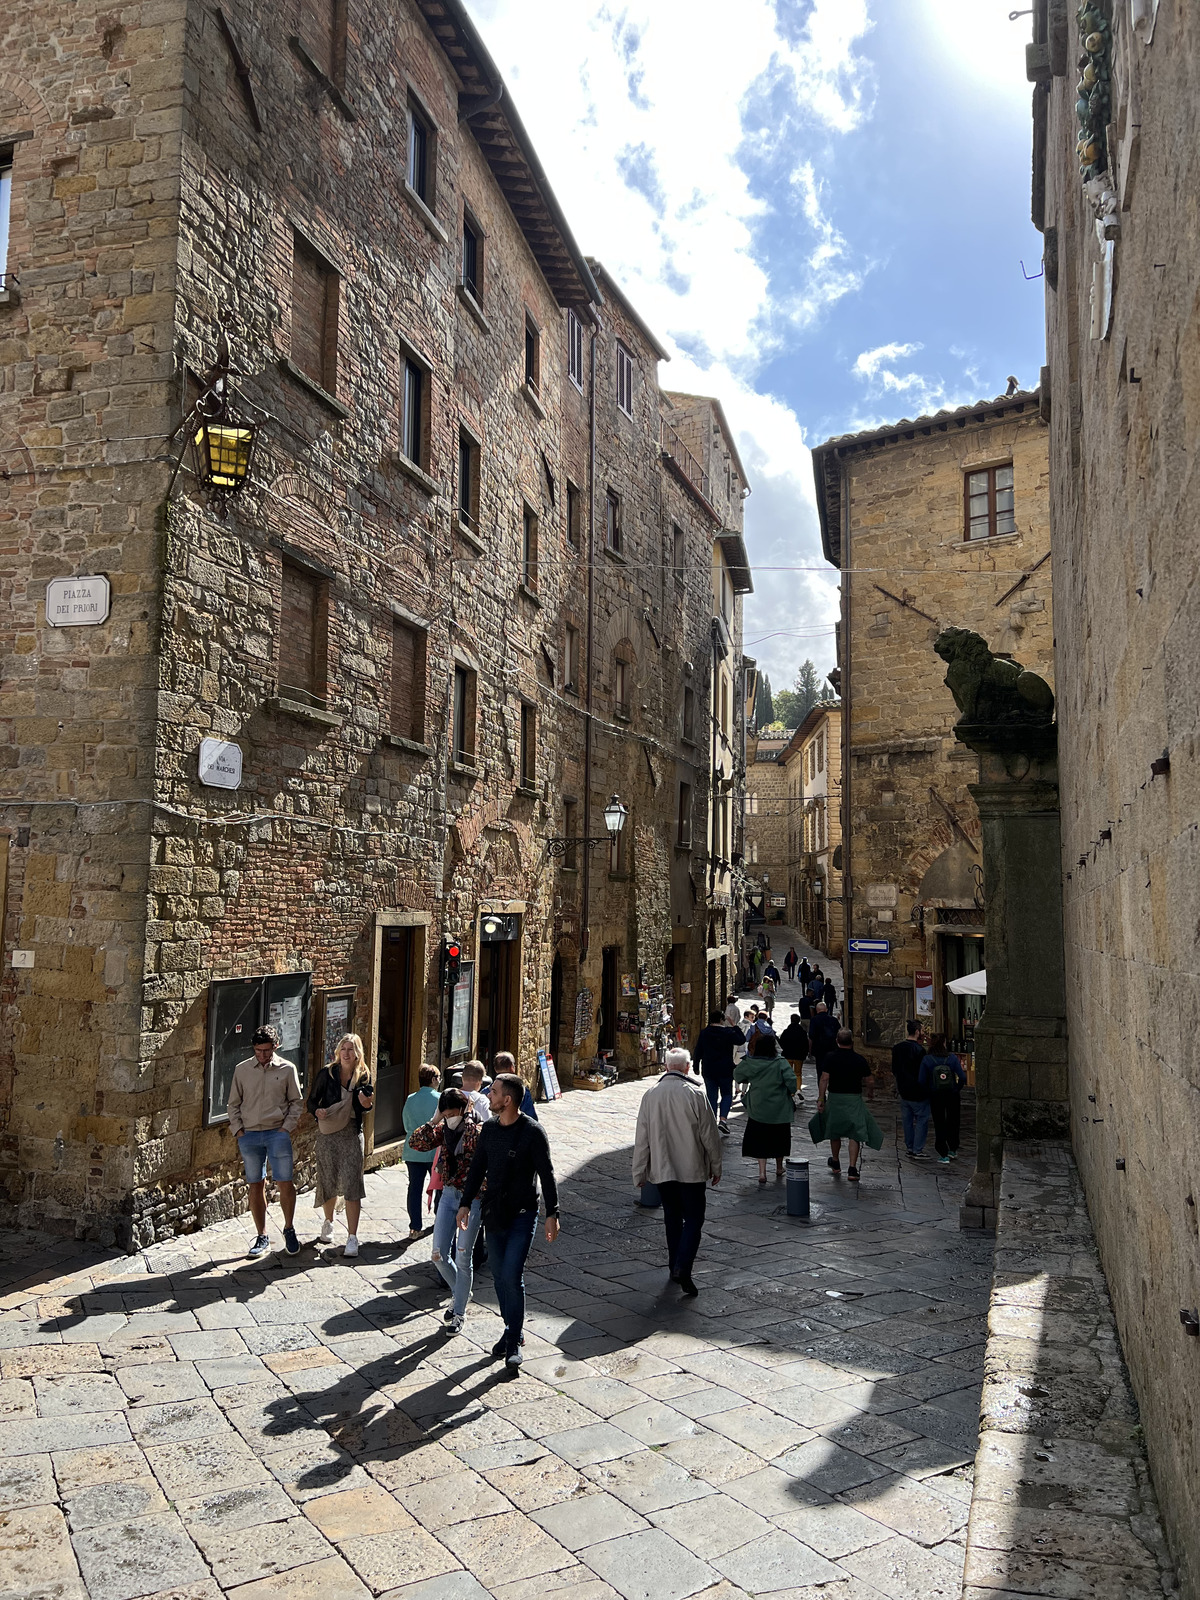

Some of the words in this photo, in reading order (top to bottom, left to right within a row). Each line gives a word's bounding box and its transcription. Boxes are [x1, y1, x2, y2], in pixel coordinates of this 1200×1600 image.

[63, 589, 92, 599] PIAZZA
[56, 605, 70, 614] DEI
[73, 603, 98, 613] PRIORI
[20, 953, 27, 965] 2
